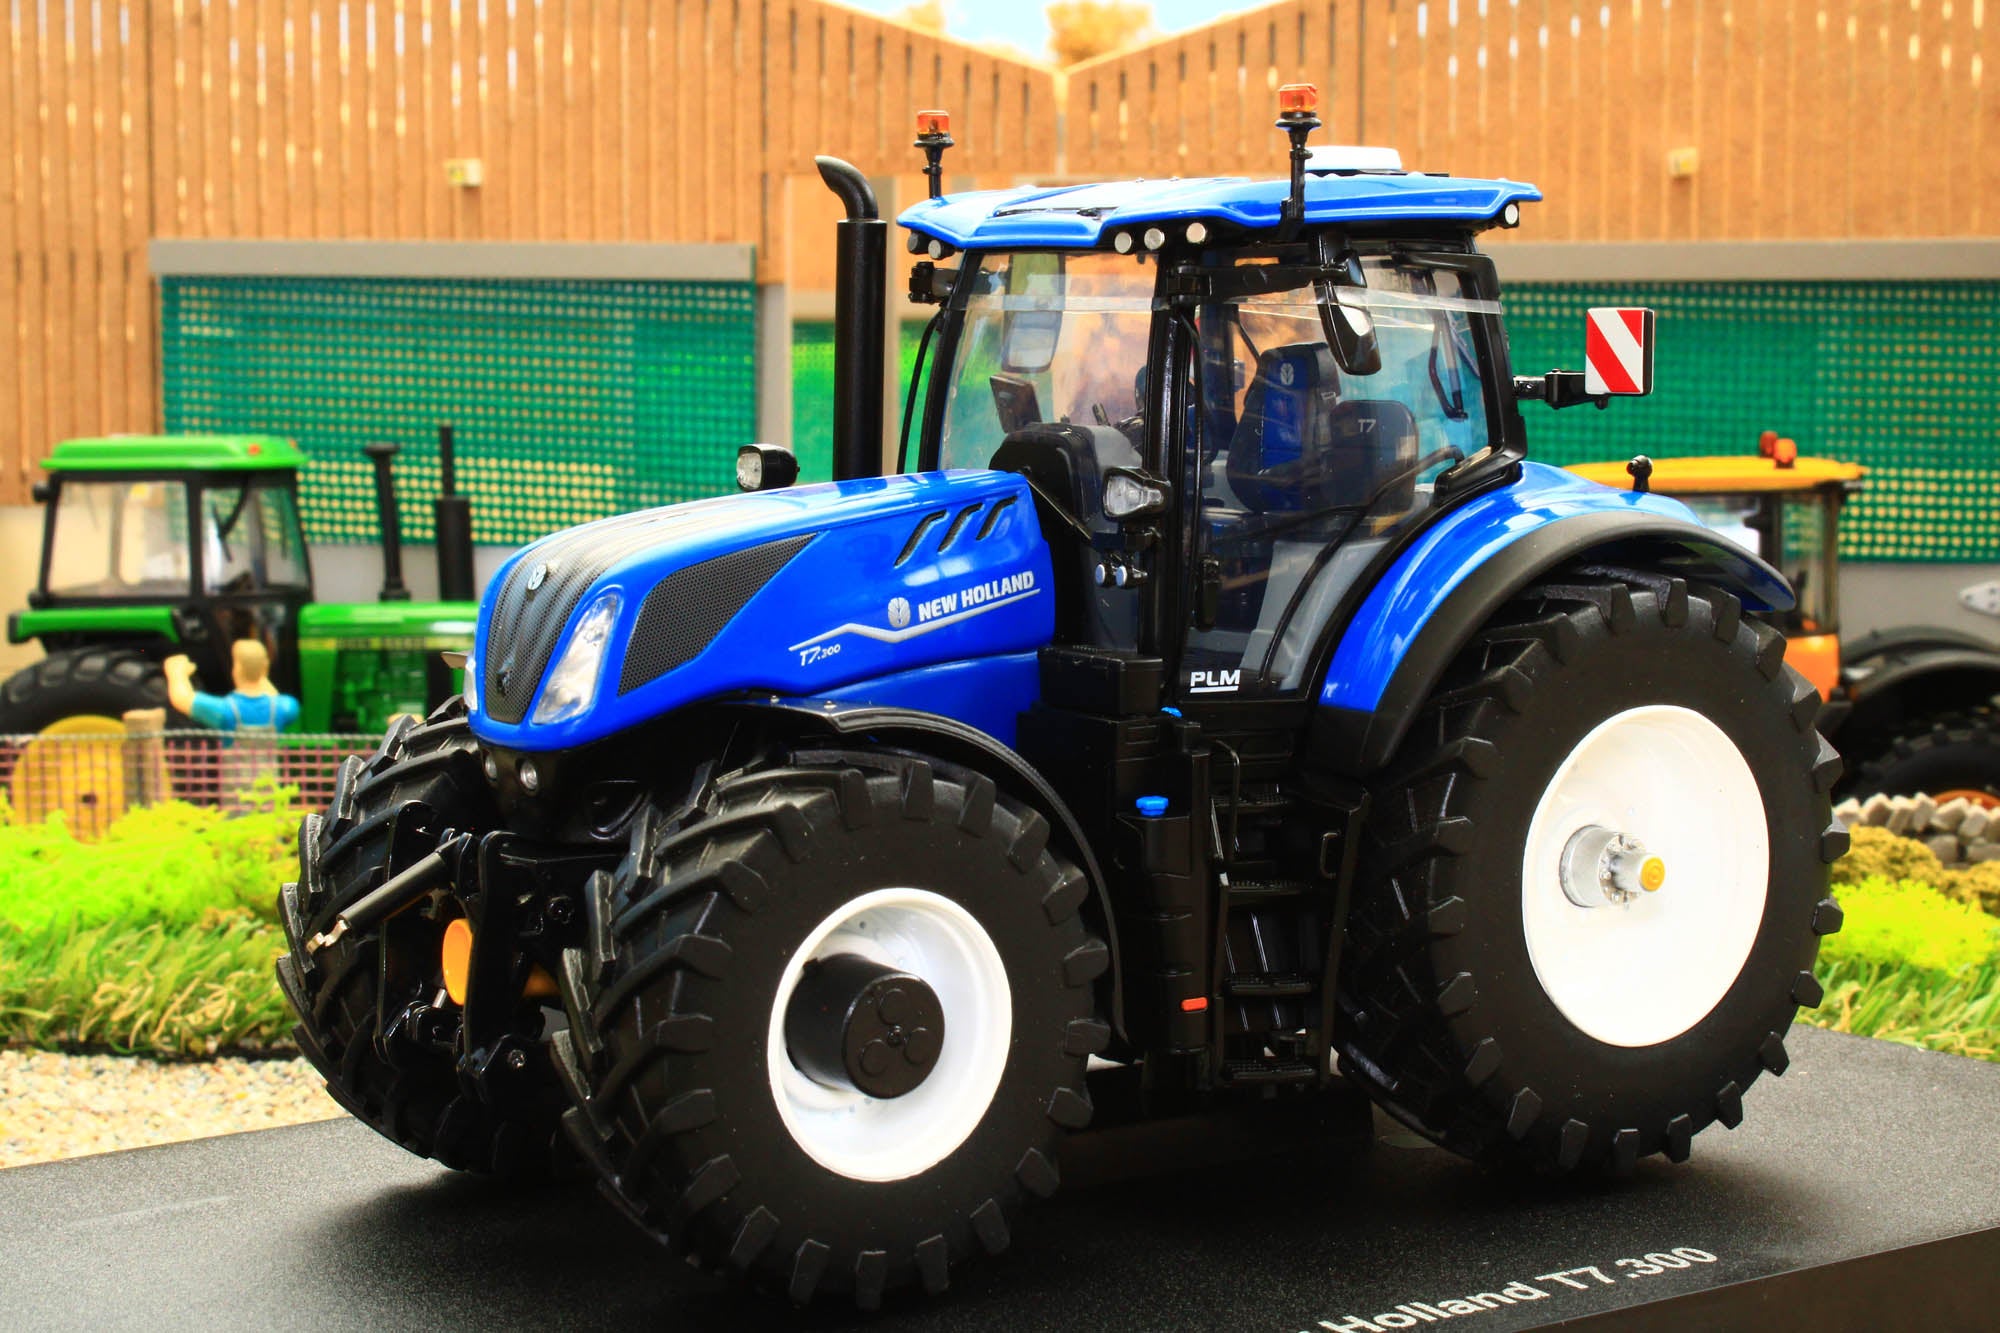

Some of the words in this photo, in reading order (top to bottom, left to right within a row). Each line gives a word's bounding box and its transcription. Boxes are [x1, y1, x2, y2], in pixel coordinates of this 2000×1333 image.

[1358, 418, 1377, 433] T7
[918, 593, 958, 622] NEW
[961, 570, 1035, 608] HOLLAND
[800, 643, 841, 667] T7.300
[1190, 669, 1241, 687] PLM
[1317, 1280, 1551, 1333] Holland
